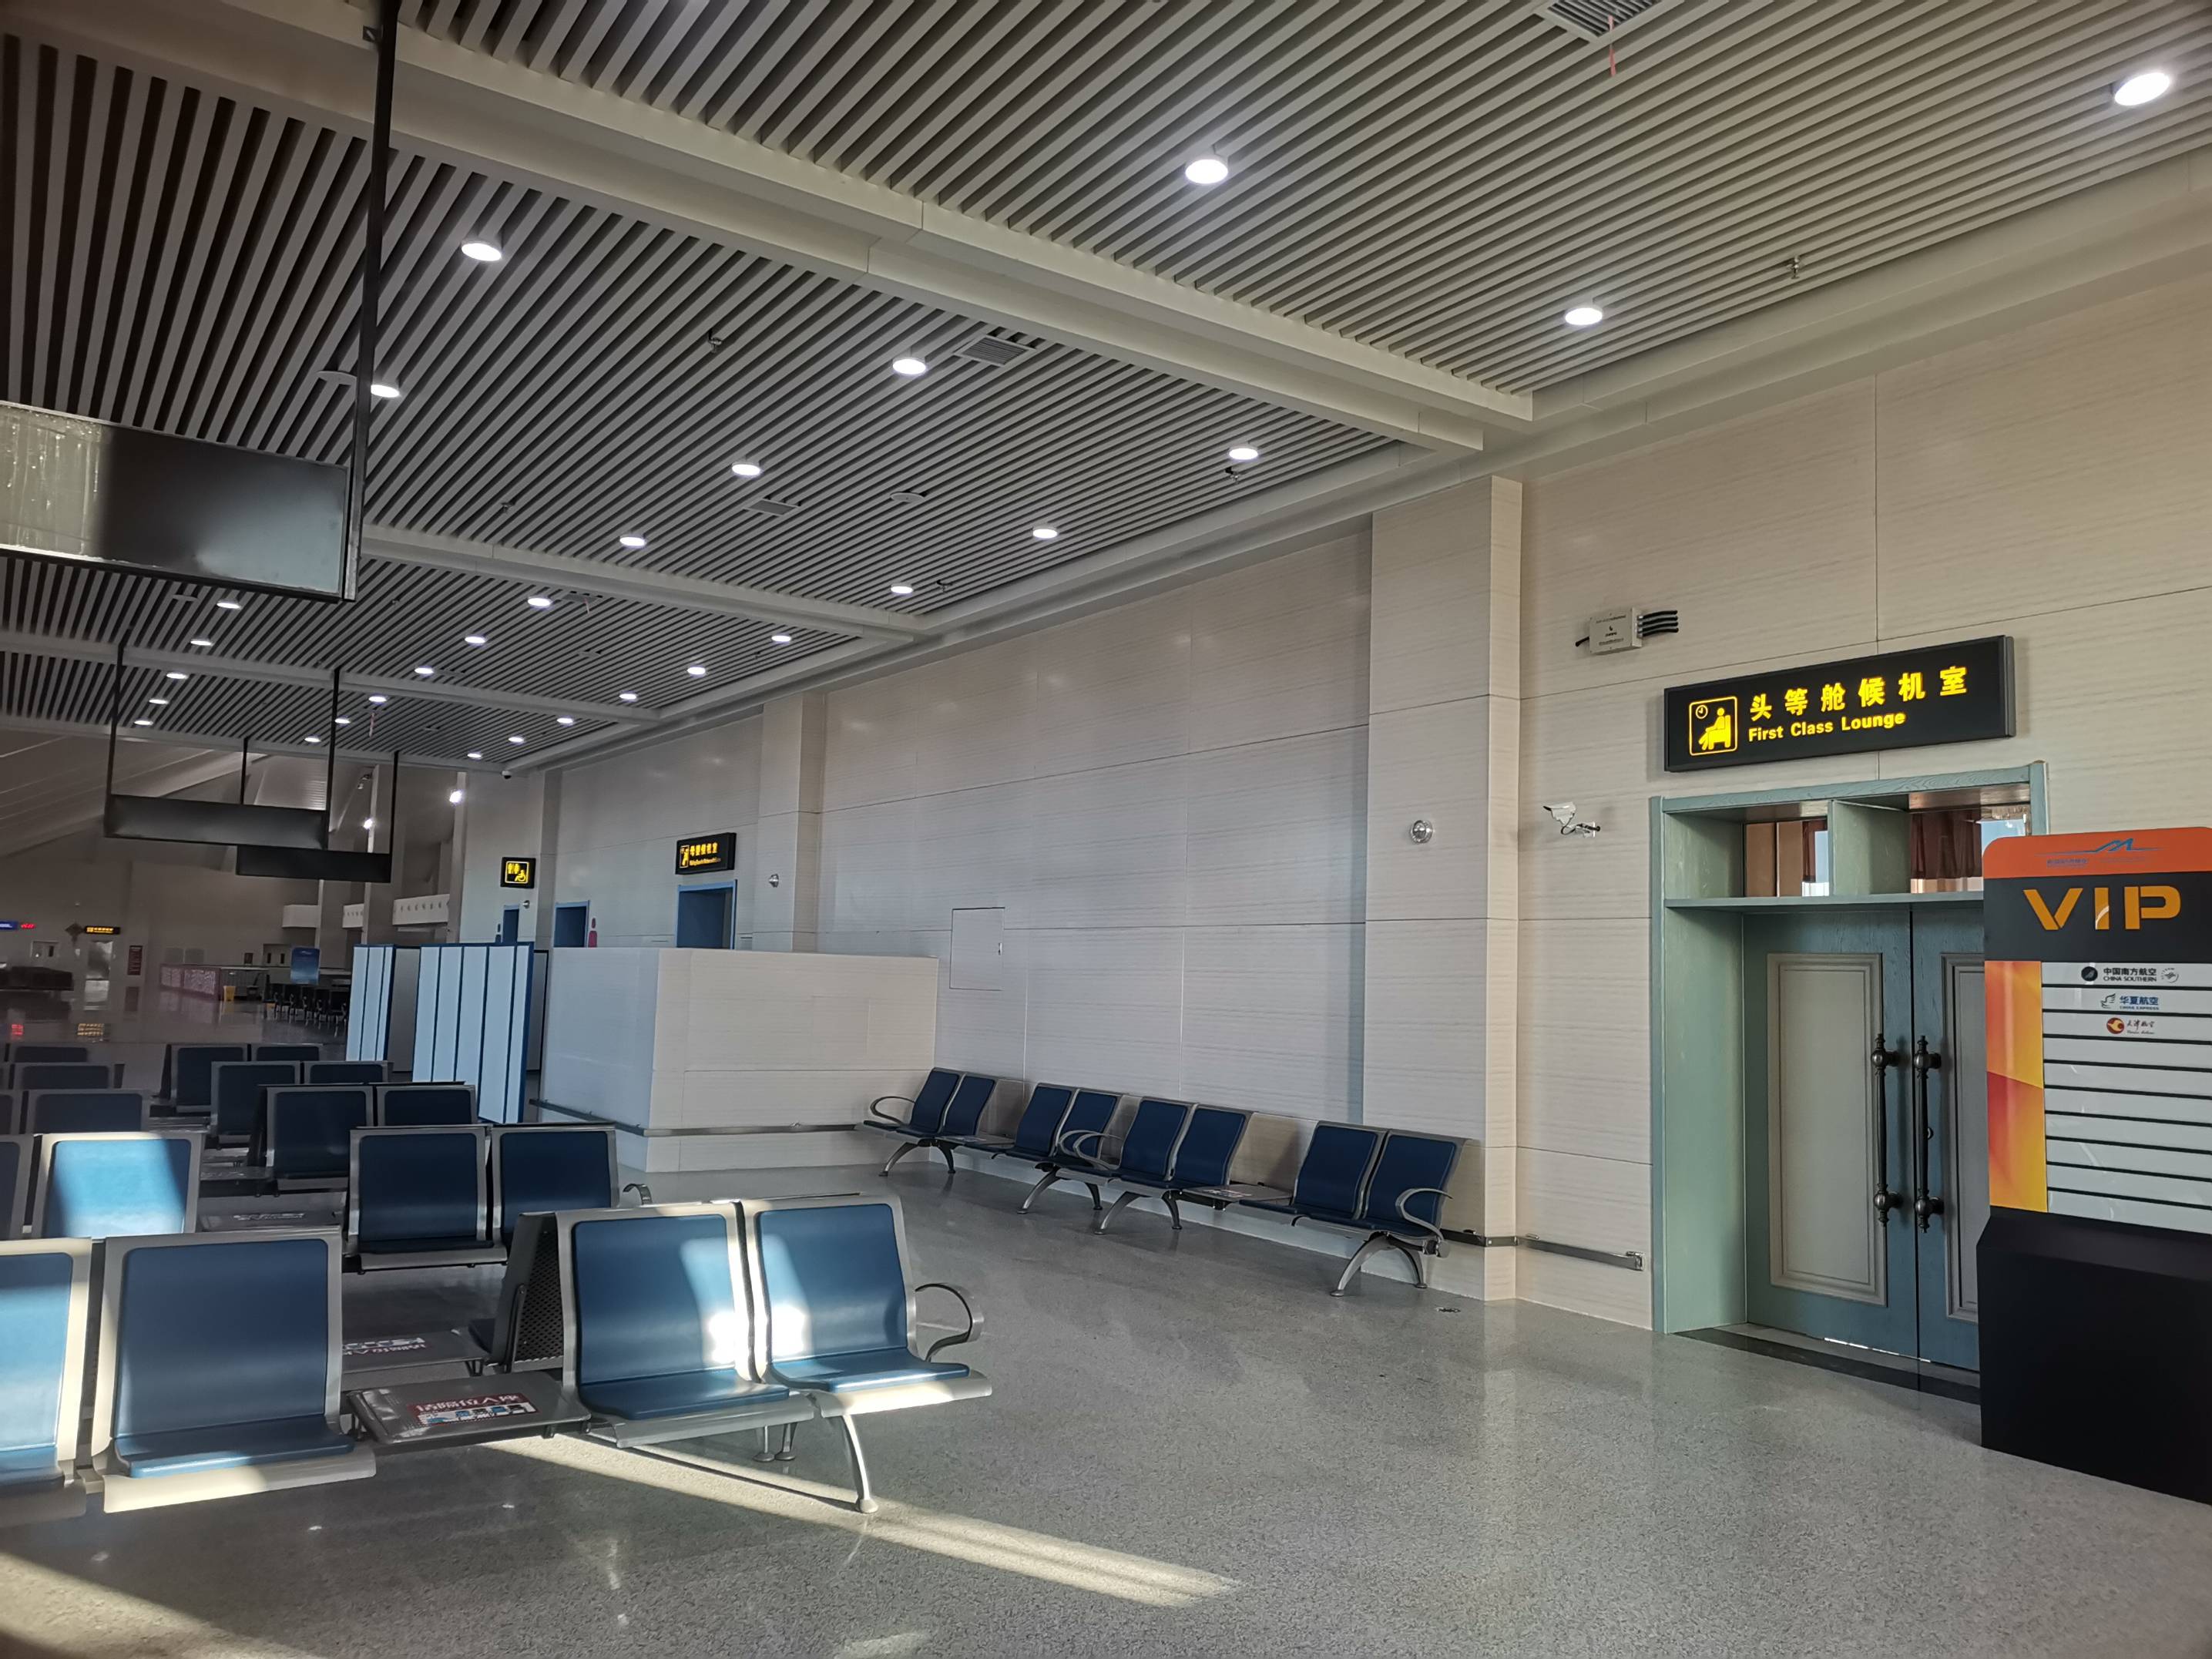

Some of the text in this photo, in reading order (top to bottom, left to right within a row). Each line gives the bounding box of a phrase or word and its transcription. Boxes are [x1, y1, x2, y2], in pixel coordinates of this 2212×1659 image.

[1750, 666, 1967, 722] 头等舱候机室
[1748, 712, 1907, 742] First Class Lounge
[2023, 885, 2181, 930] VIP
[2103, 967, 2157, 976] 中国南方航空
[2120, 996, 2158, 1005] 华夏航空
